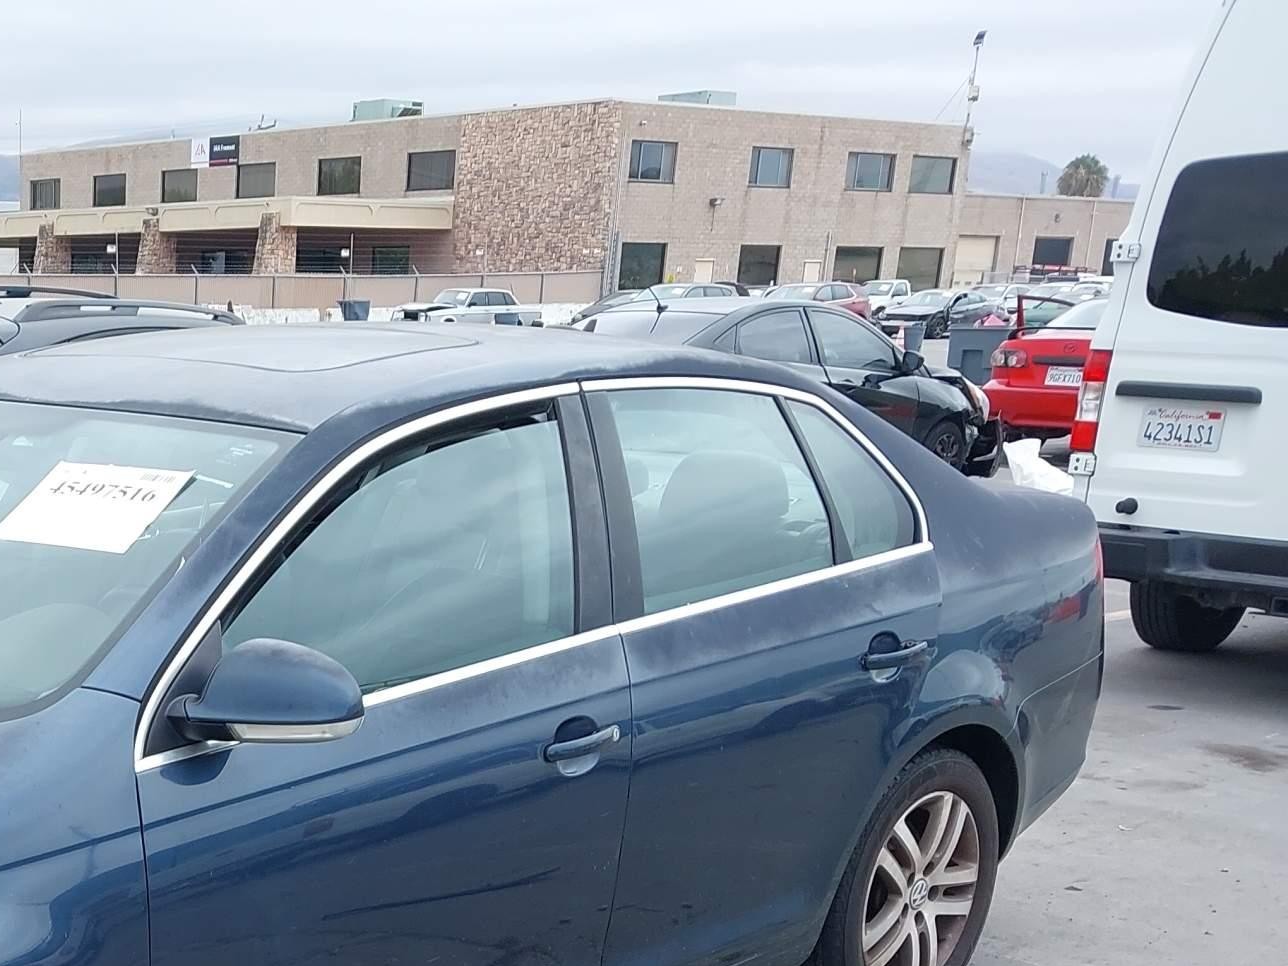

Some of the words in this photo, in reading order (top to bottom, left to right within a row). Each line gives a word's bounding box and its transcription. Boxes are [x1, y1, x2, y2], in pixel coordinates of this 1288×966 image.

[1047, 372, 1082, 384] 9GFX710
[1159, 407, 1205, 421] California
[1143, 421, 1214, 445] 42341S1
[49, 480, 157, 502] 45497516
